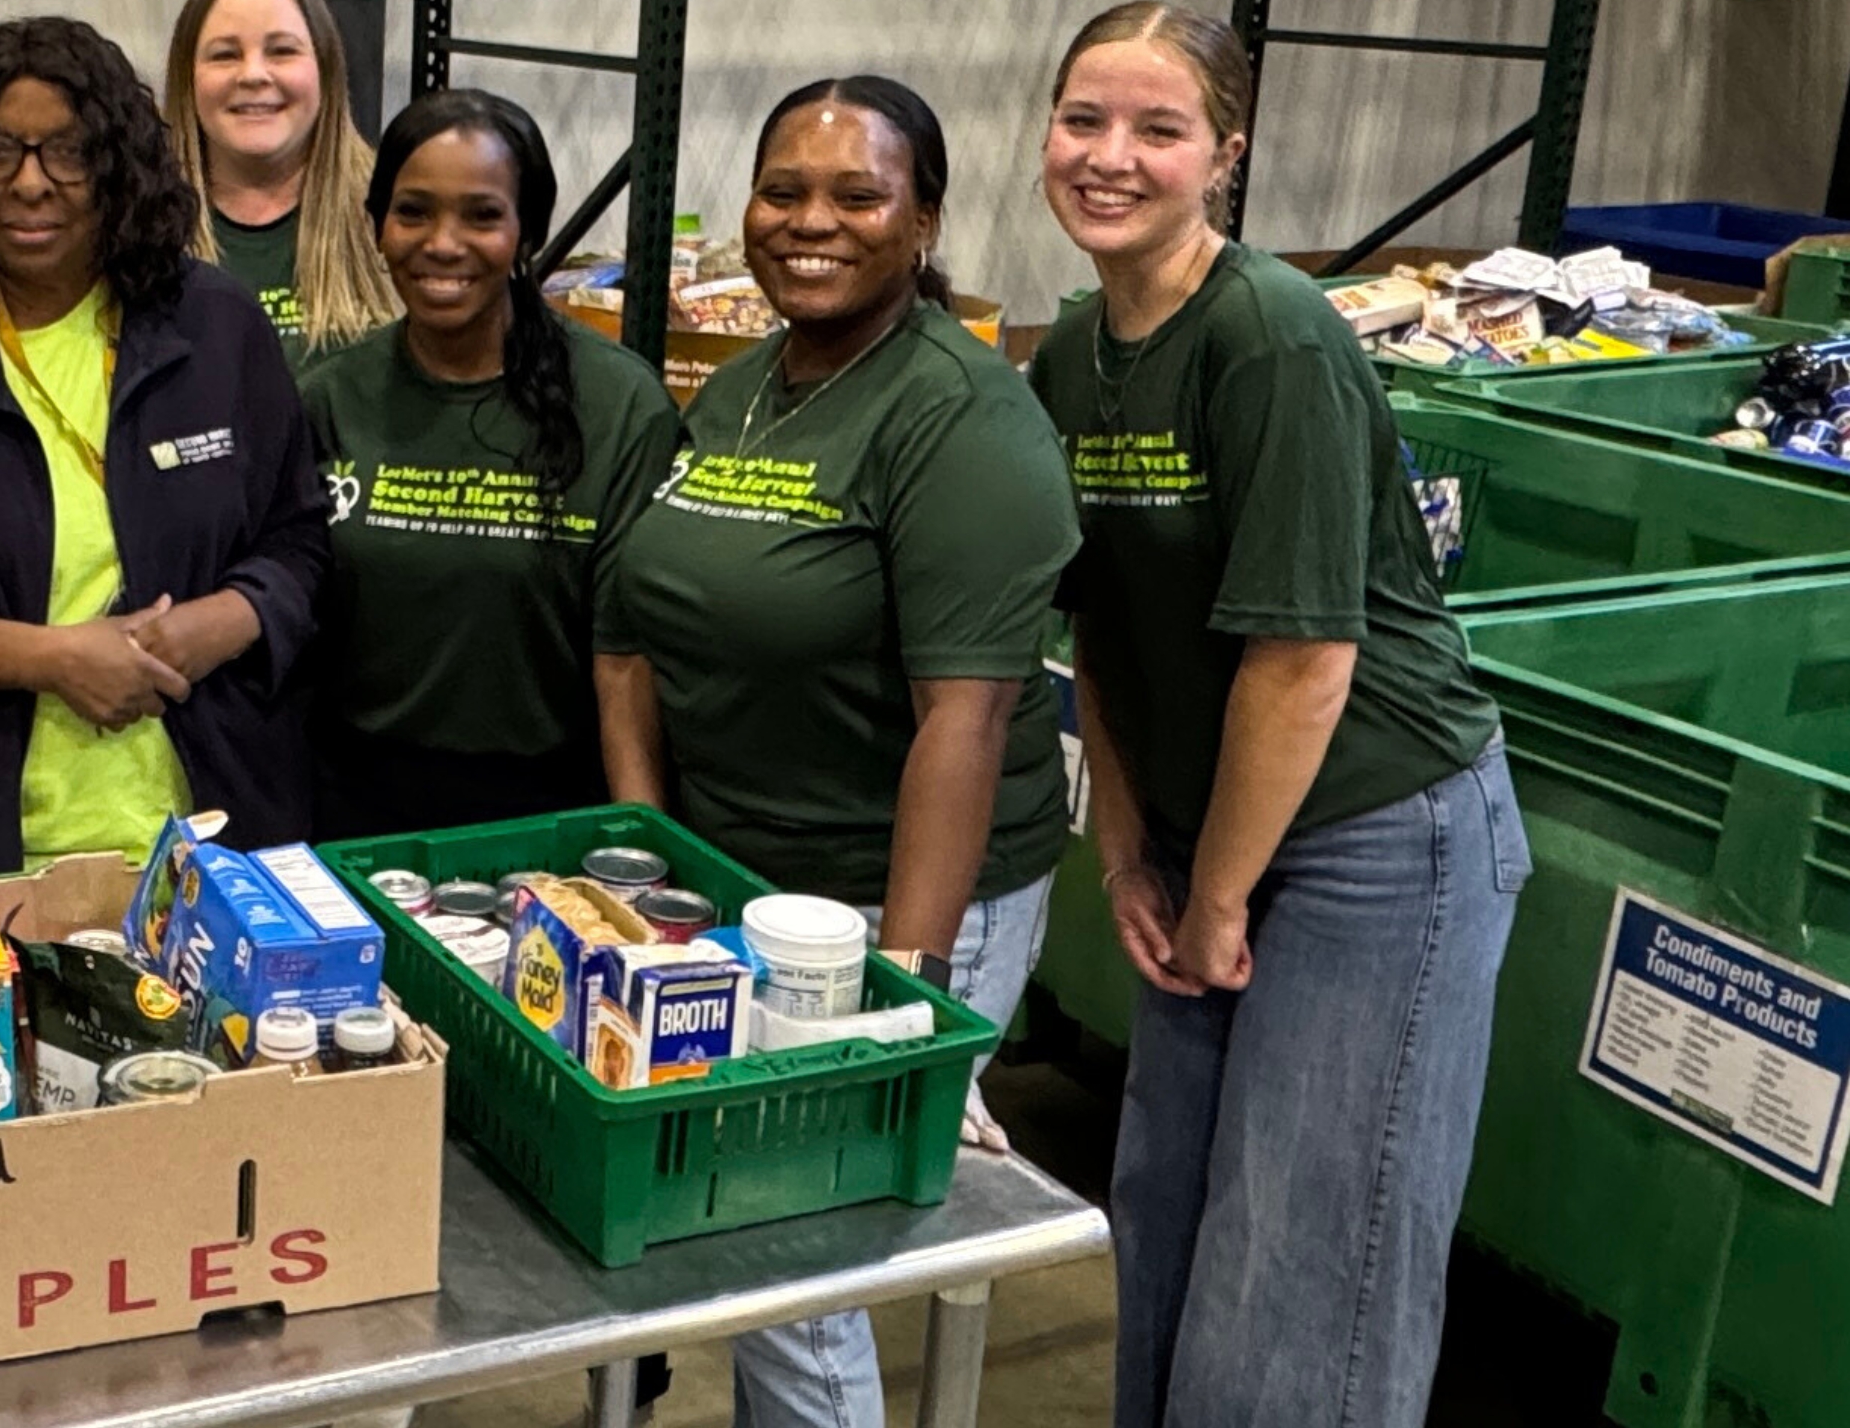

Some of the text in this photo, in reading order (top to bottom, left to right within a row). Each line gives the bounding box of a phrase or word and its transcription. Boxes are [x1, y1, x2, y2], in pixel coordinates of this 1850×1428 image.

[372, 480, 458, 503] Second
[377, 464, 443, 484] LorMet's
[368, 497, 434, 517] Member
[436, 505, 511, 523] Matching
[1653, 924, 1822, 1021] Condiments and
[658, 997, 729, 1038] BROTH
[1645, 946, 1718, 1001] Tomato
[1720, 987, 1818, 1050] Products
[64, 1012, 133, 1052] NAVITAS
